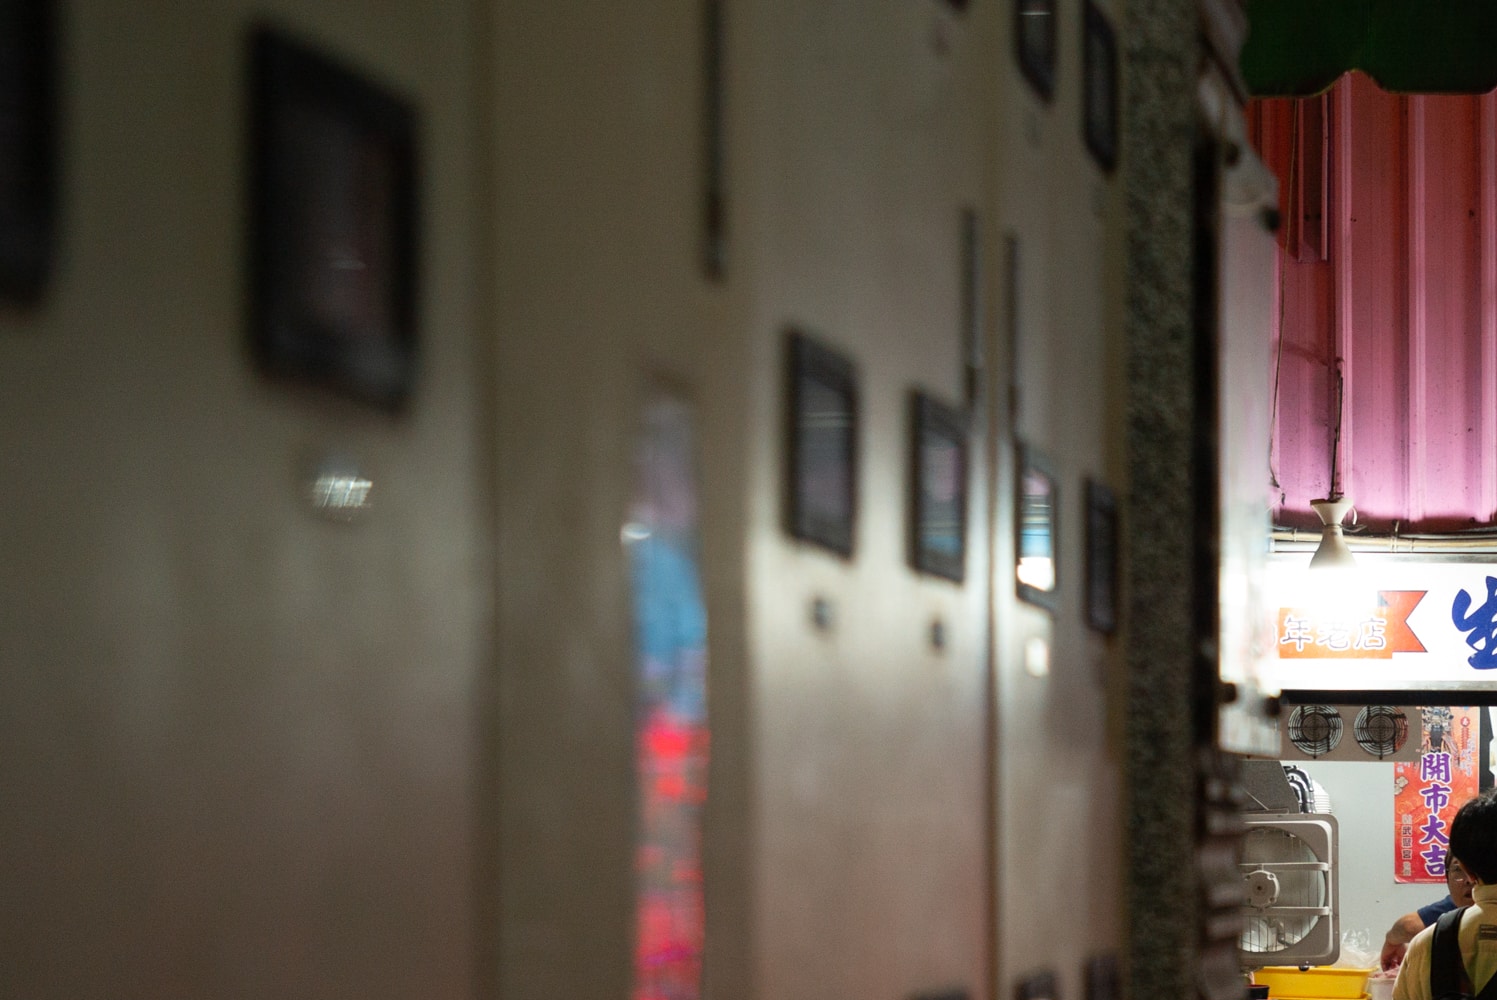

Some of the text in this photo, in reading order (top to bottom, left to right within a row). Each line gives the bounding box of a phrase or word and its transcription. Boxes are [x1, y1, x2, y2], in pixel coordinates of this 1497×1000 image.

[1273, 616, 1387, 651] 年老店
[1419, 752, 1453, 877] 開市大吉
